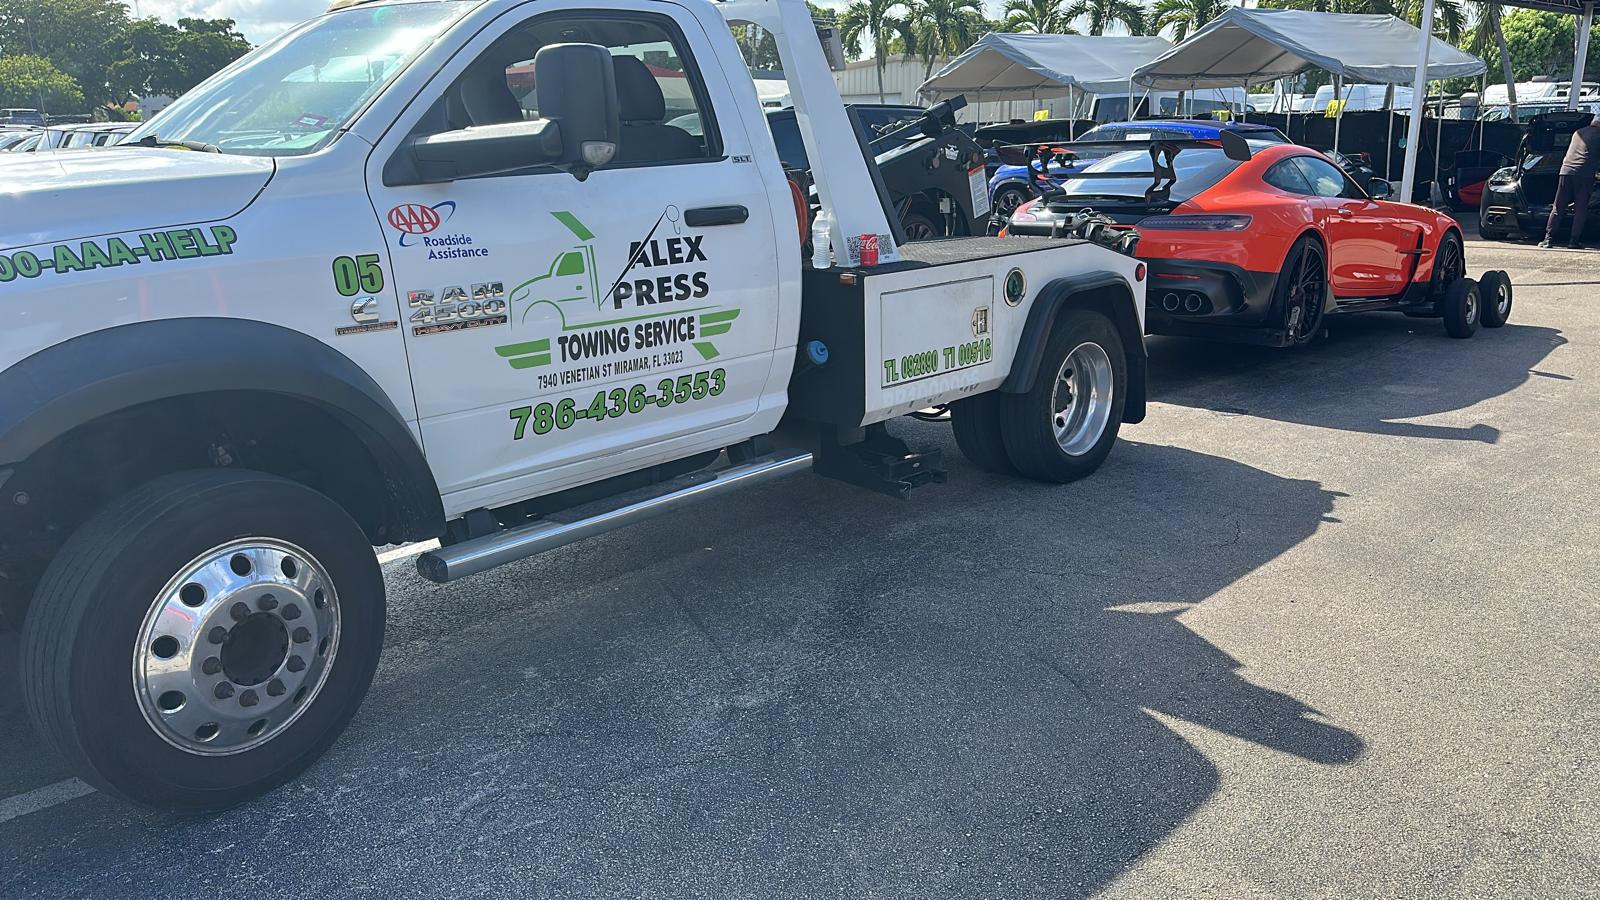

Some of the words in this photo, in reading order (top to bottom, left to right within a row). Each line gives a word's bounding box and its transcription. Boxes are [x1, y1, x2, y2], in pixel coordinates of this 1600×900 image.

[731, 155, 752, 164] SLT
[388, 204, 440, 234] AAA
[424, 234, 472, 247] Roadside
[428, 247, 489, 260] Assistance
[628, 235, 707, 270] ALEX
[332, 253, 385, 297] 05
[612, 271, 709, 310] PRESS
[407, 281, 504, 308] RAM
[409, 300, 506, 323] 4500
[557, 326, 630, 363] TOWING
[634, 316, 696, 350] SERVICE
[538, 373, 558, 390] 7940
[559, 368, 600, 385] VENETIAN
[602, 363, 613, 378] ST
[614, 356, 651, 376] MIRAMAR,
[652, 354, 662, 368] FL
[663, 350, 684, 366] 33023
[884, 358, 899, 383] TL
[901, 349, 938, 380] 092890
[958, 337, 992, 367] 00516
[509, 367, 727, 441] 786-436-3553
